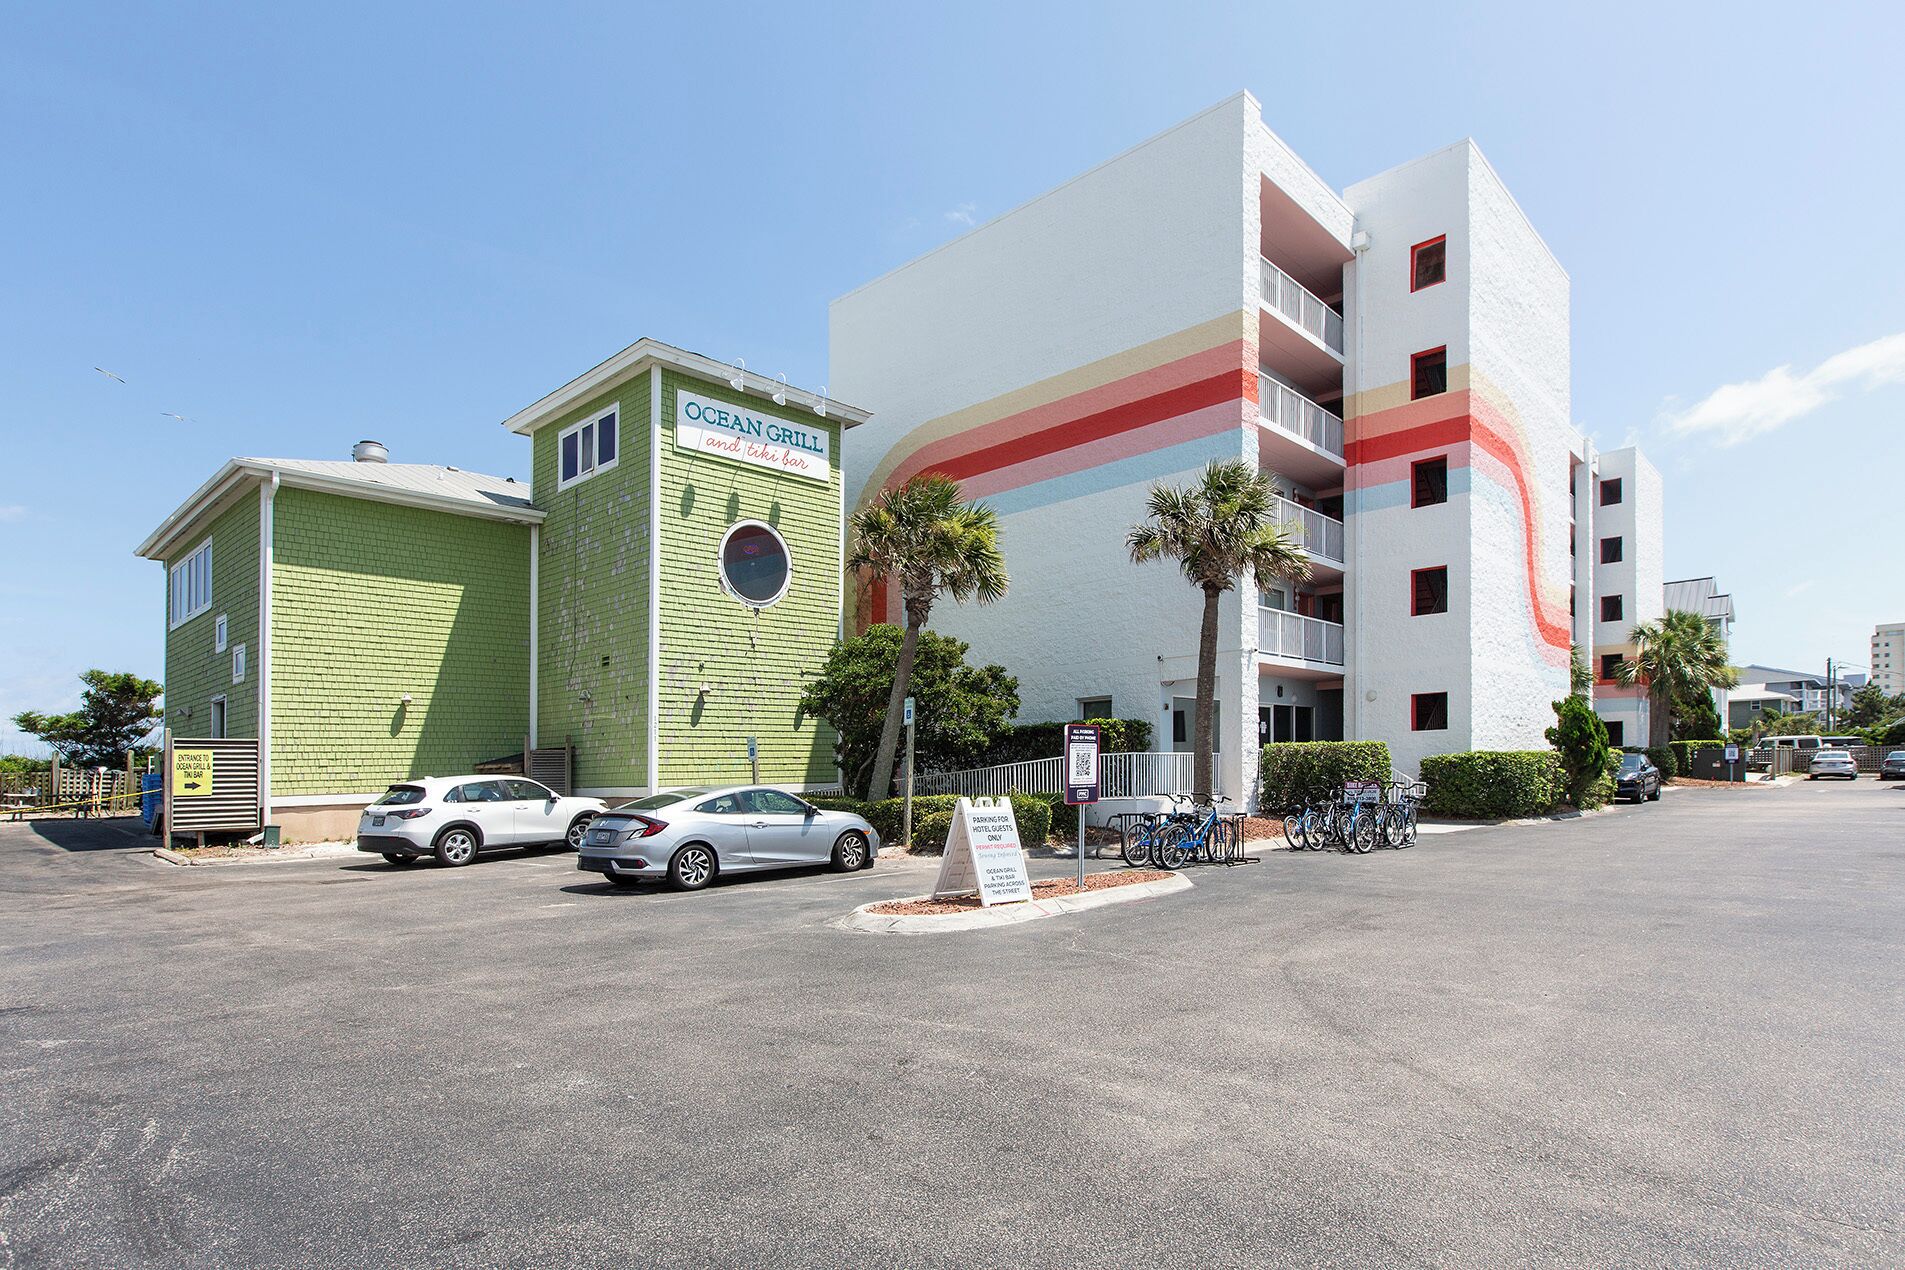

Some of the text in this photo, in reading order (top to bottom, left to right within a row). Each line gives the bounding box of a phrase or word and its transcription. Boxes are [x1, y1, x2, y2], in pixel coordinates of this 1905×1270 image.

[684, 401, 824, 453] OCEAN GRILL
[706, 437, 809, 469] and tiki bar
